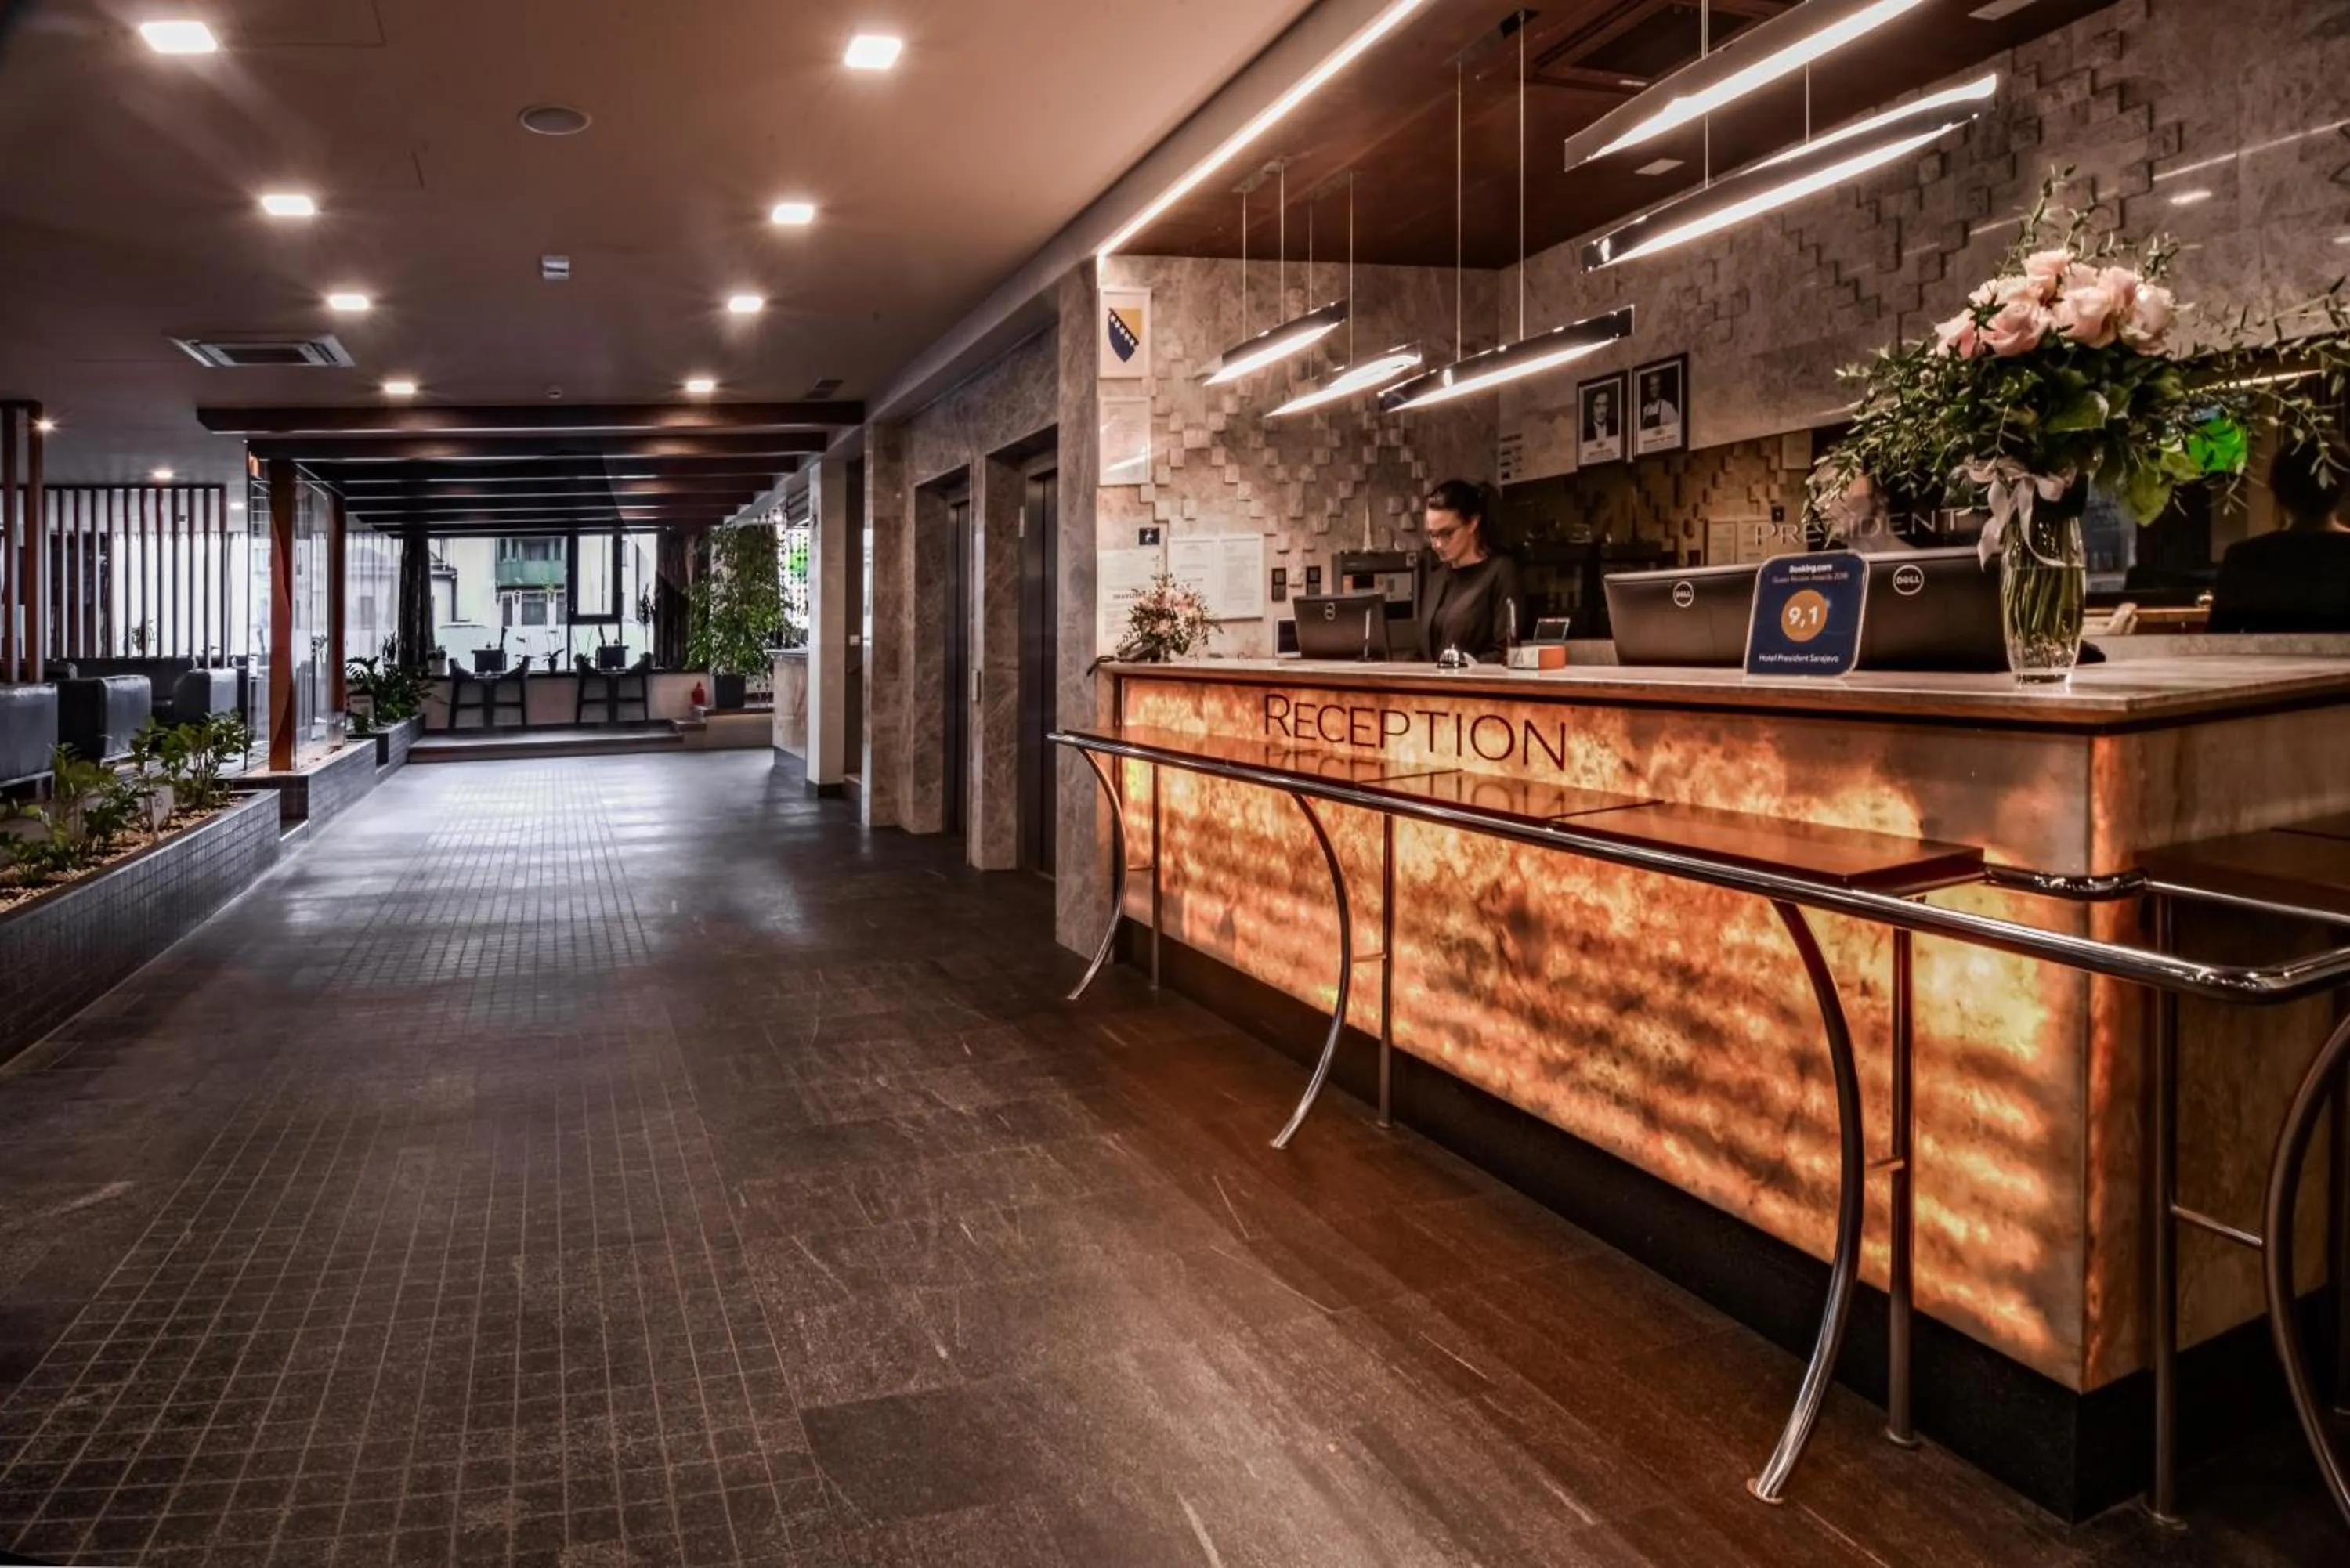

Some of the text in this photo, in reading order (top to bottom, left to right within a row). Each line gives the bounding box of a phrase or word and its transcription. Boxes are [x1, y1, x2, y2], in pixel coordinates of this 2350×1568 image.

[1755, 508, 1961, 547] PREIDENT
[1789, 564, 1832, 573] Booking.com
[1896, 575, 1920, 586] DELL
[1788, 605, 1820, 627] 9,1
[1759, 653, 1838, 663] Hotel President Sarajevo
[1263, 693, 1567, 771] RECEPTION
